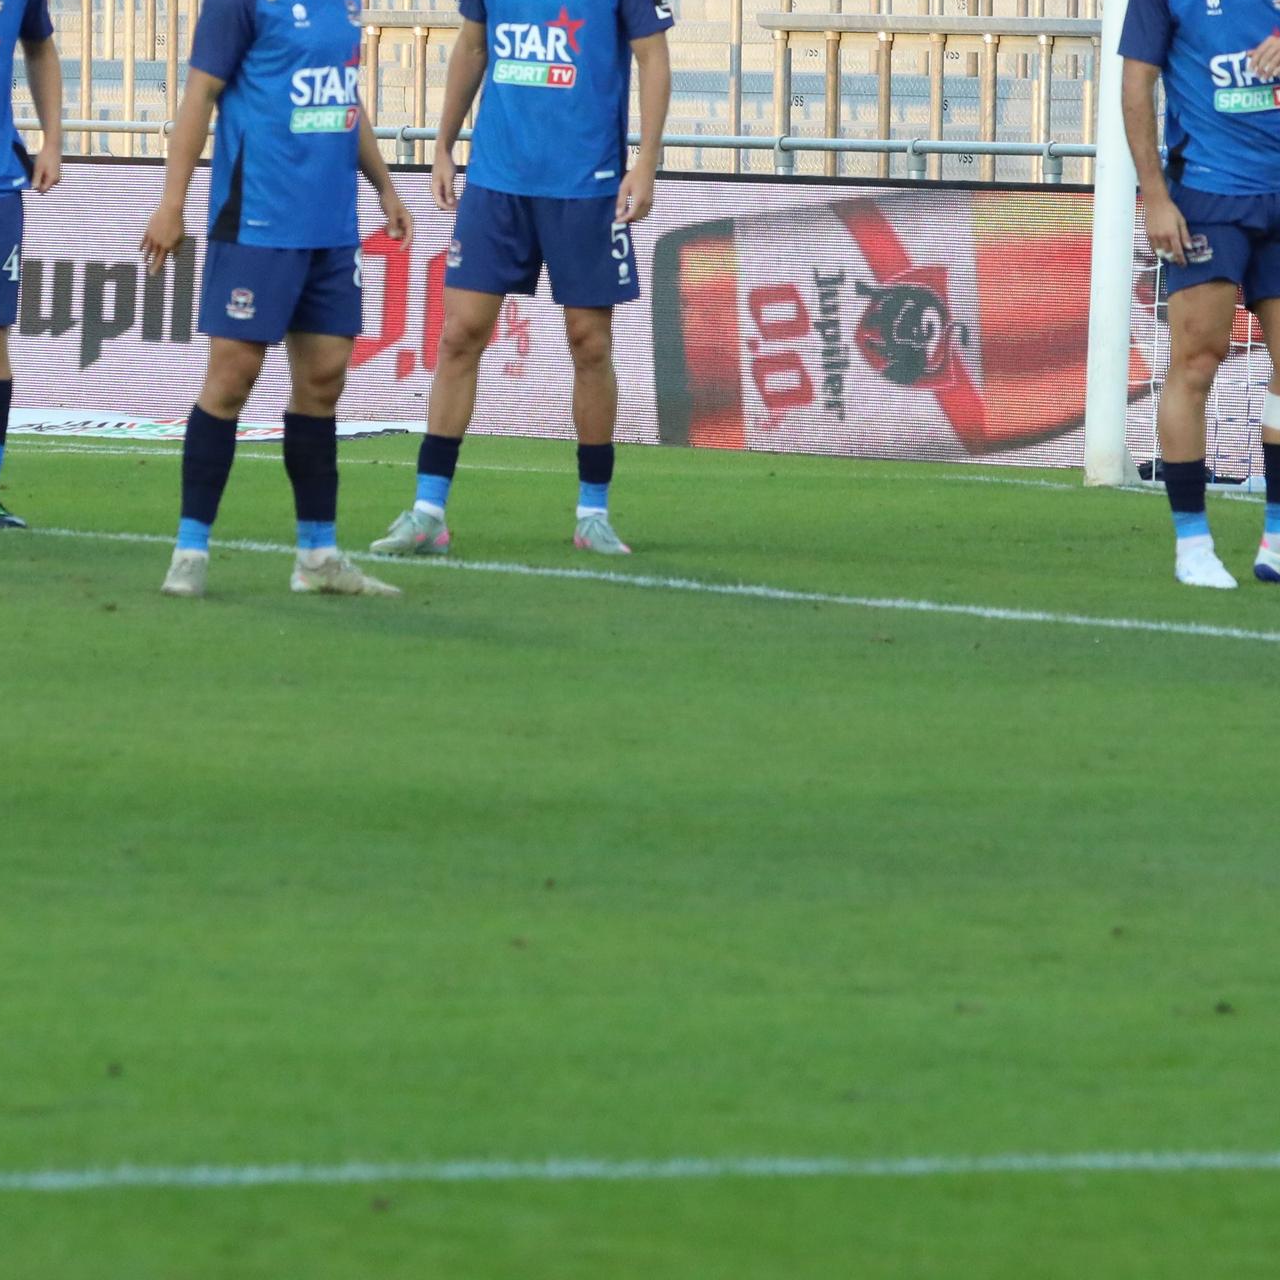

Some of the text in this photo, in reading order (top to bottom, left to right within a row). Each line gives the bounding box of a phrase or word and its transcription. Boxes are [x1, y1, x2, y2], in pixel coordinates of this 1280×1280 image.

[493, 22, 573, 63] STAR
[290, 66, 358, 106] STAR
[496, 64, 573, 83] SPORT TV
[1218, 91, 1271, 109] SPORT
[292, 110, 345, 129] SPORT
[610, 221, 629, 260] 5
[2, 244, 20, 282] 4
